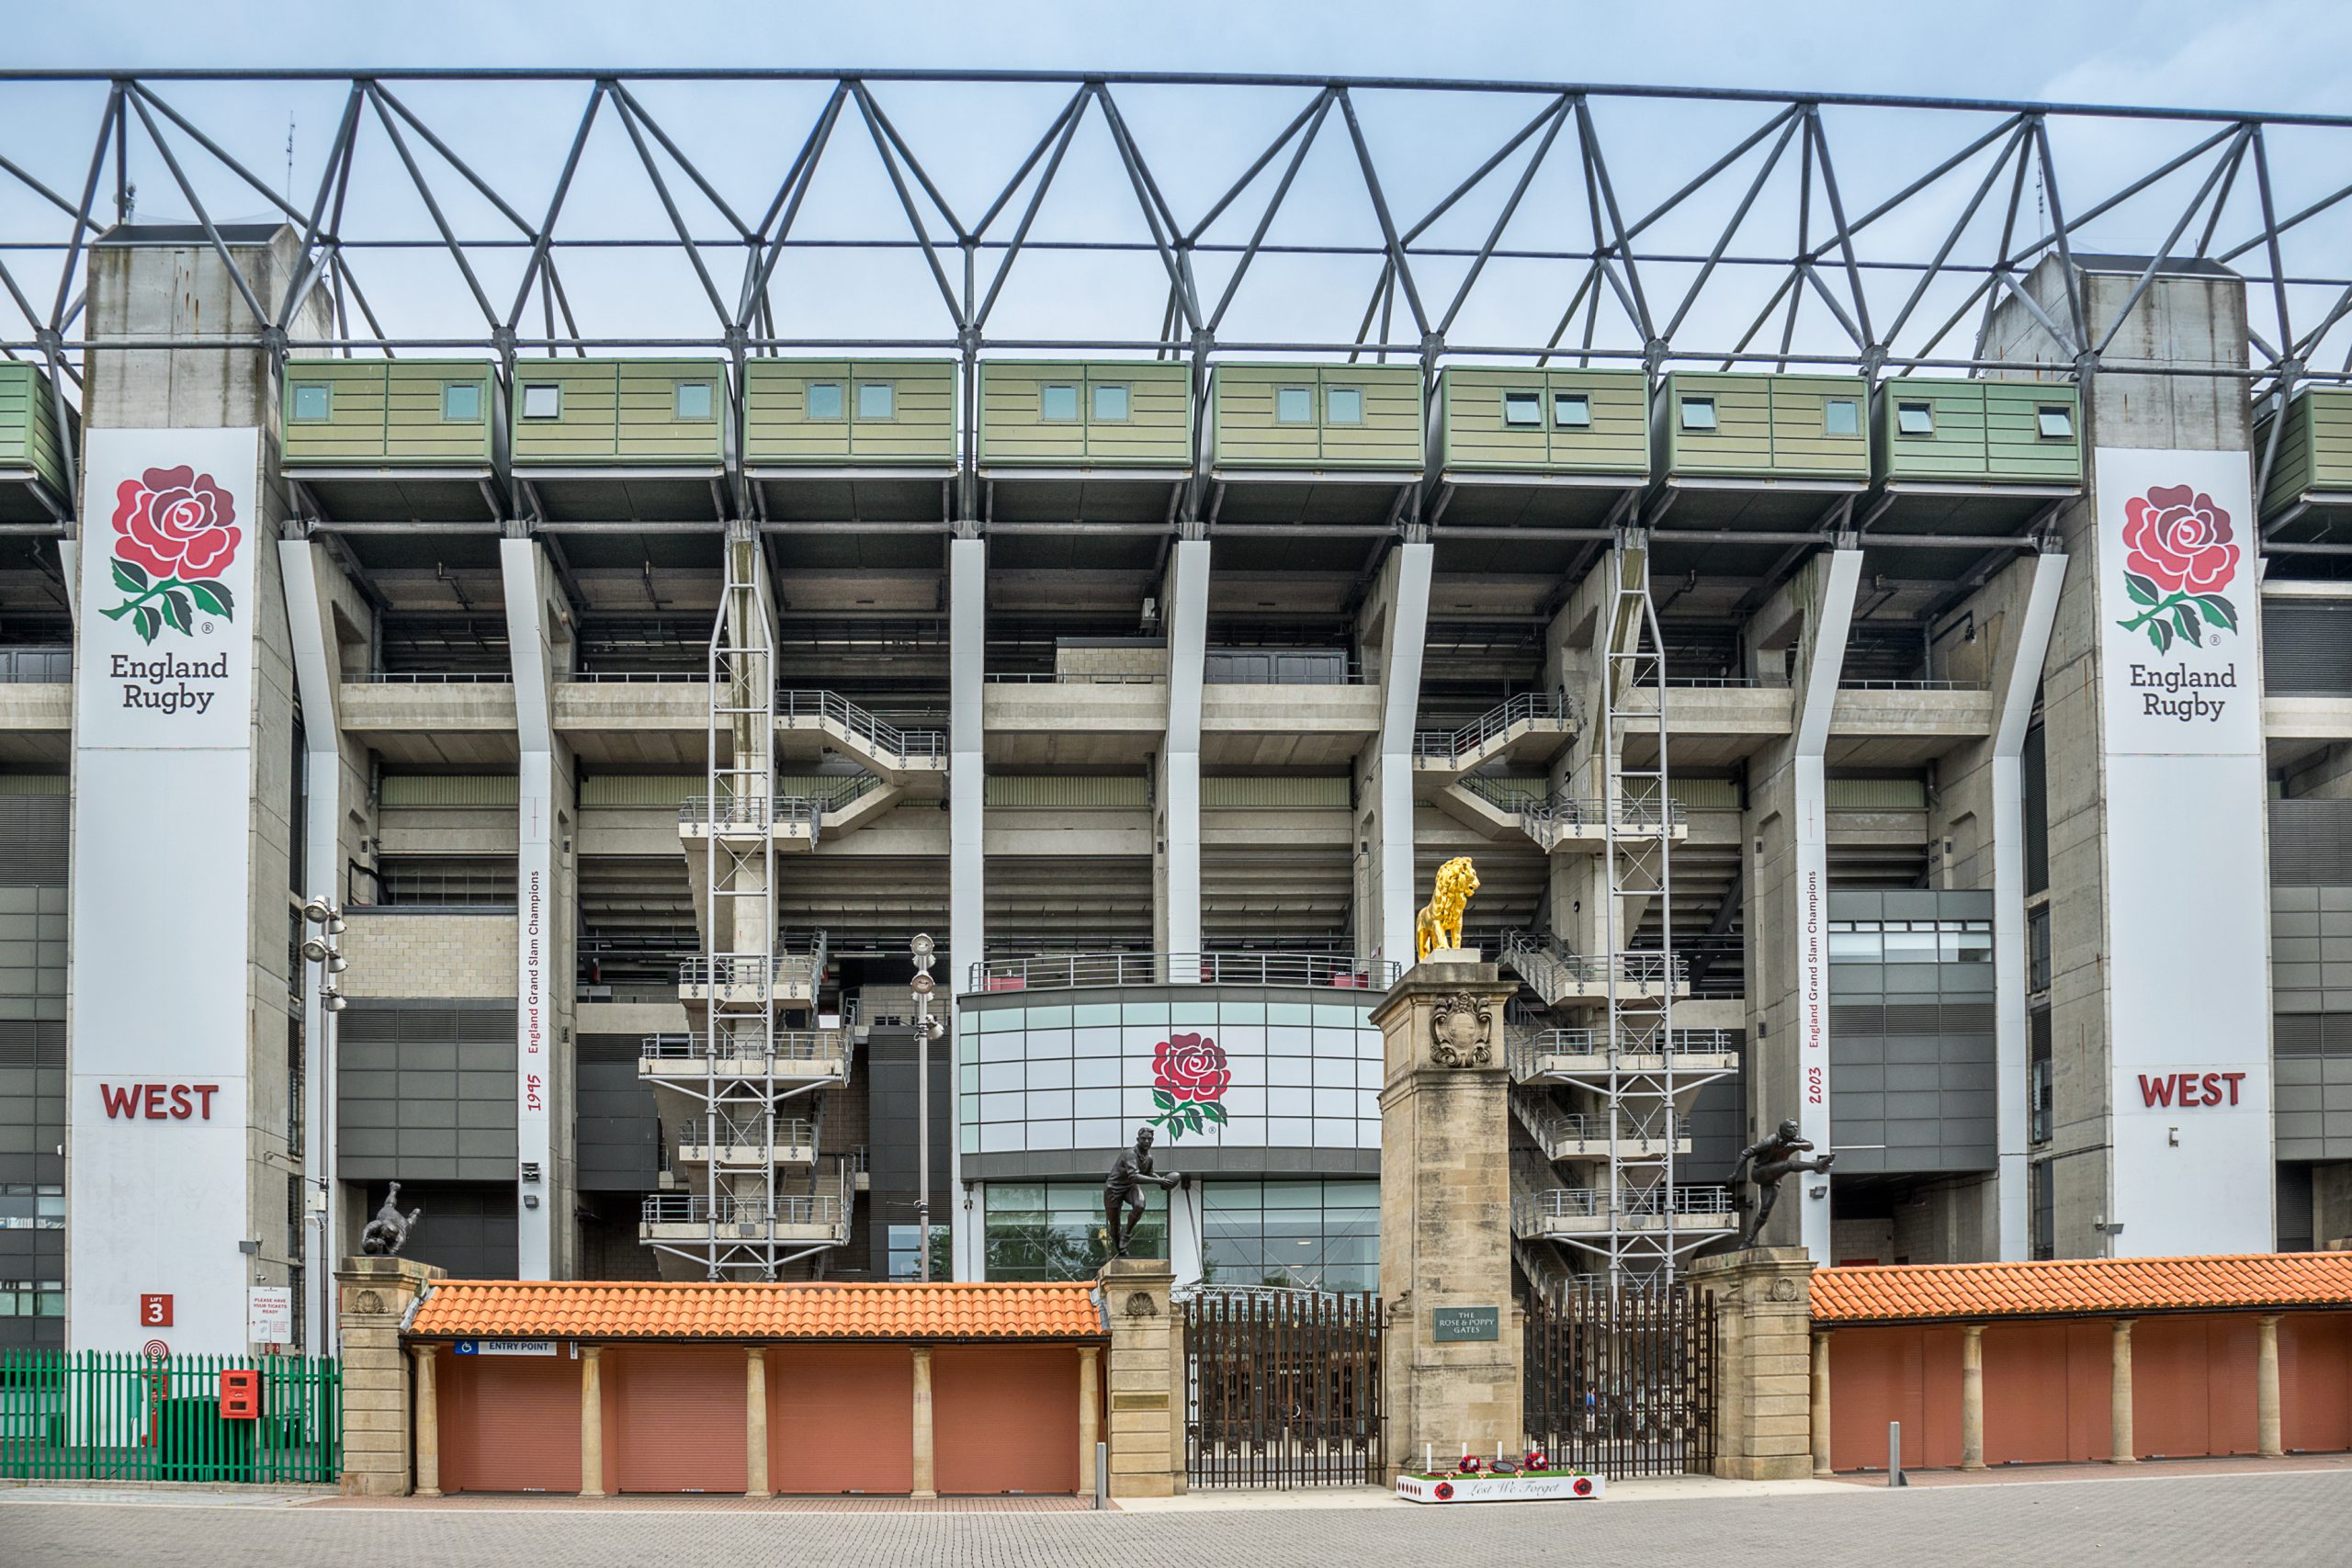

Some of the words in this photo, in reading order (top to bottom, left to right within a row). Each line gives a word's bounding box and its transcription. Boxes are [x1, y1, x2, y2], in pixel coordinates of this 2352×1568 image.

[110, 652, 229, 684] England
[2130, 662, 2236, 693] England
[123, 682, 214, 715] Rugby
[2143, 692, 2225, 722] Rugby
[528, 870, 541, 936] Champions
[1807, 870, 1820, 934] Champions
[528, 938, 538, 966] Slam
[1808, 936, 1818, 964] Slam
[528, 969, 538, 1005] Grand
[1808, 966, 1818, 1001] Grand
[528, 1008, 540, 1055] England
[1809, 1004, 1821, 1048] England
[100, 1083, 220, 1120] WEST
[527, 1074, 541, 1111] 1995
[1809, 1066, 1822, 1104] 2003
[2138, 1073, 2246, 1108] WEST
[148, 1303, 164, 1323] 3
[1453, 1325, 1480, 1334] GATES
[489, 1342, 518, 1350] ENTRY
[521, 1342, 548, 1350] POINT
[1469, 1482, 1492, 1496] Lest
[1498, 1481, 1516, 1494] We
[1520, 1480, 1559, 1496] Forget
